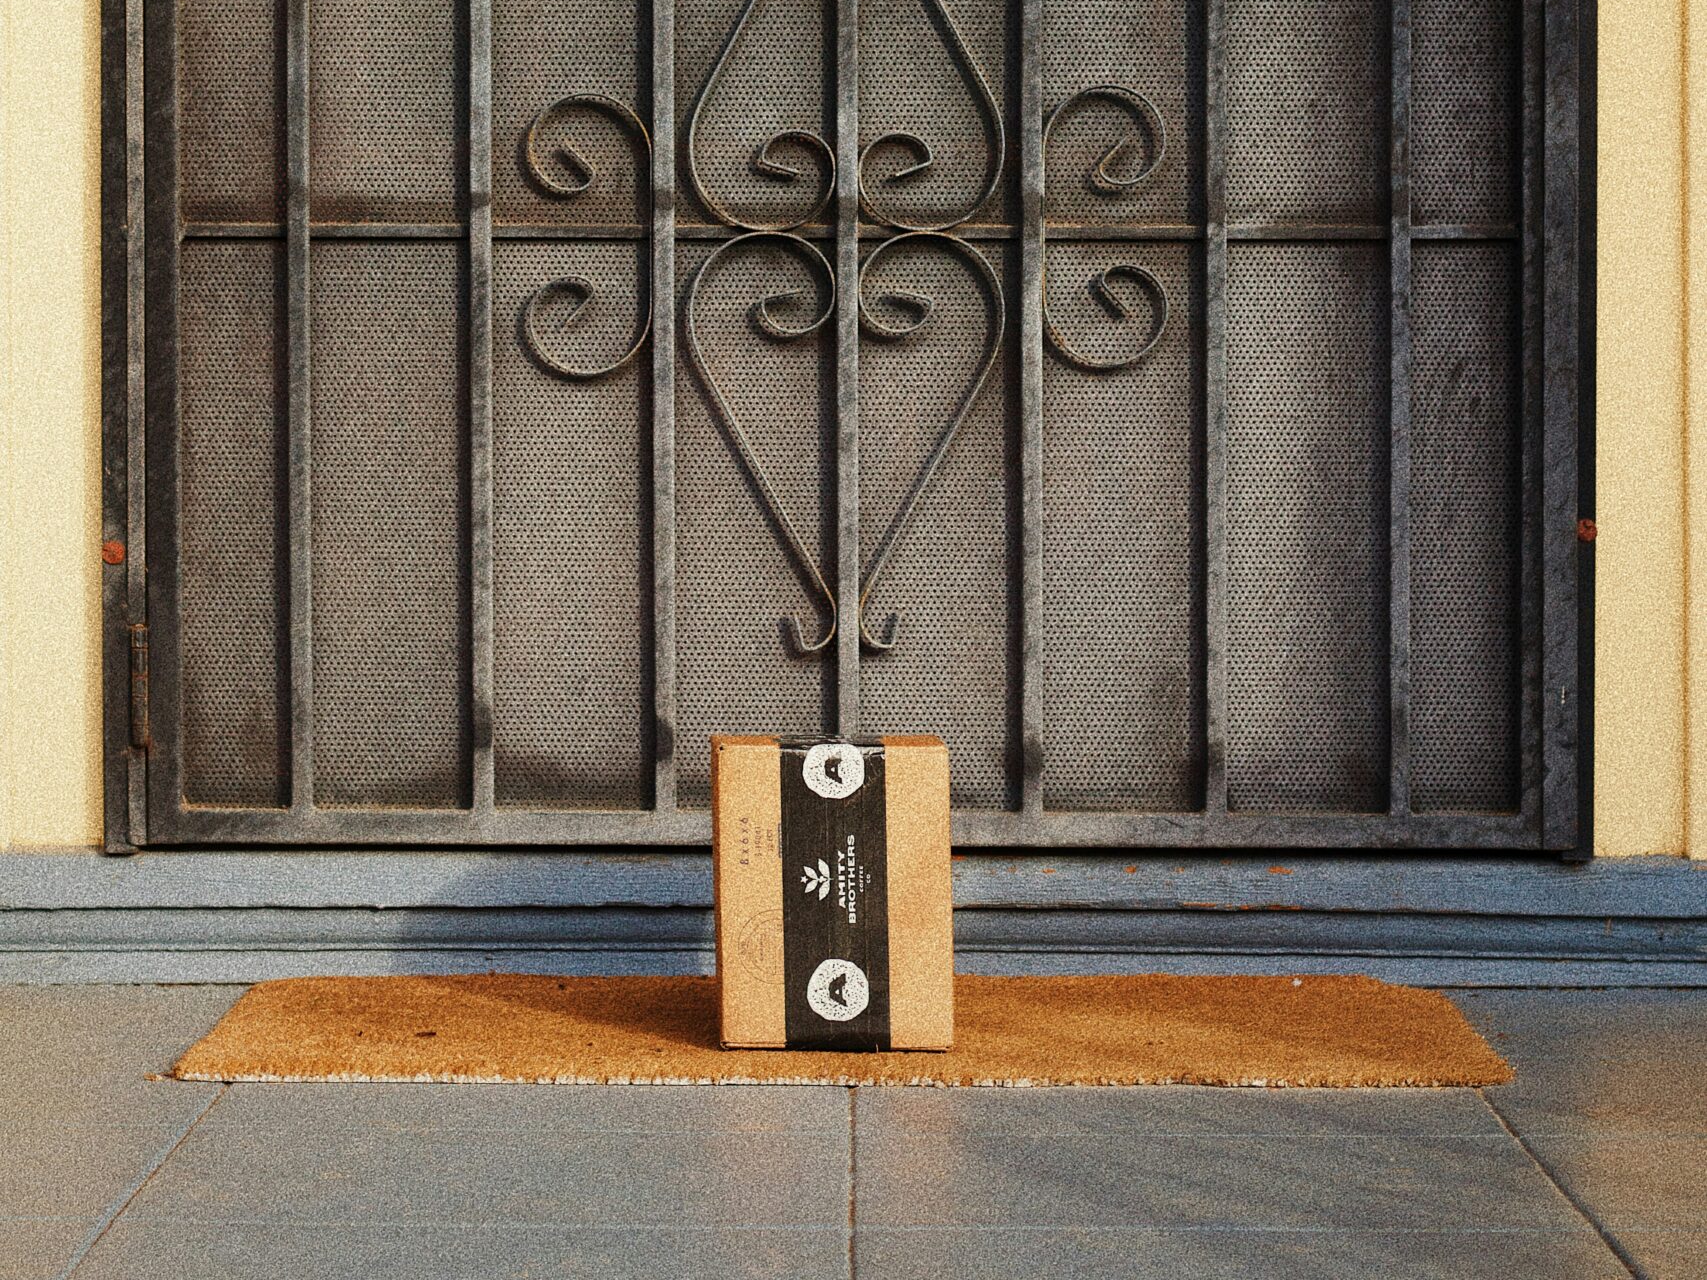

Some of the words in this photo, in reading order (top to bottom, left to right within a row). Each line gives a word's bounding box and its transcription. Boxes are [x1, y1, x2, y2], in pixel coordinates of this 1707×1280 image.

[824, 751, 843, 784] A
[837, 850, 846, 909] AMITY
[847, 834, 857, 924] BROTHERS
[866, 873, 871, 884] CO
[828, 973, 848, 1007] A
